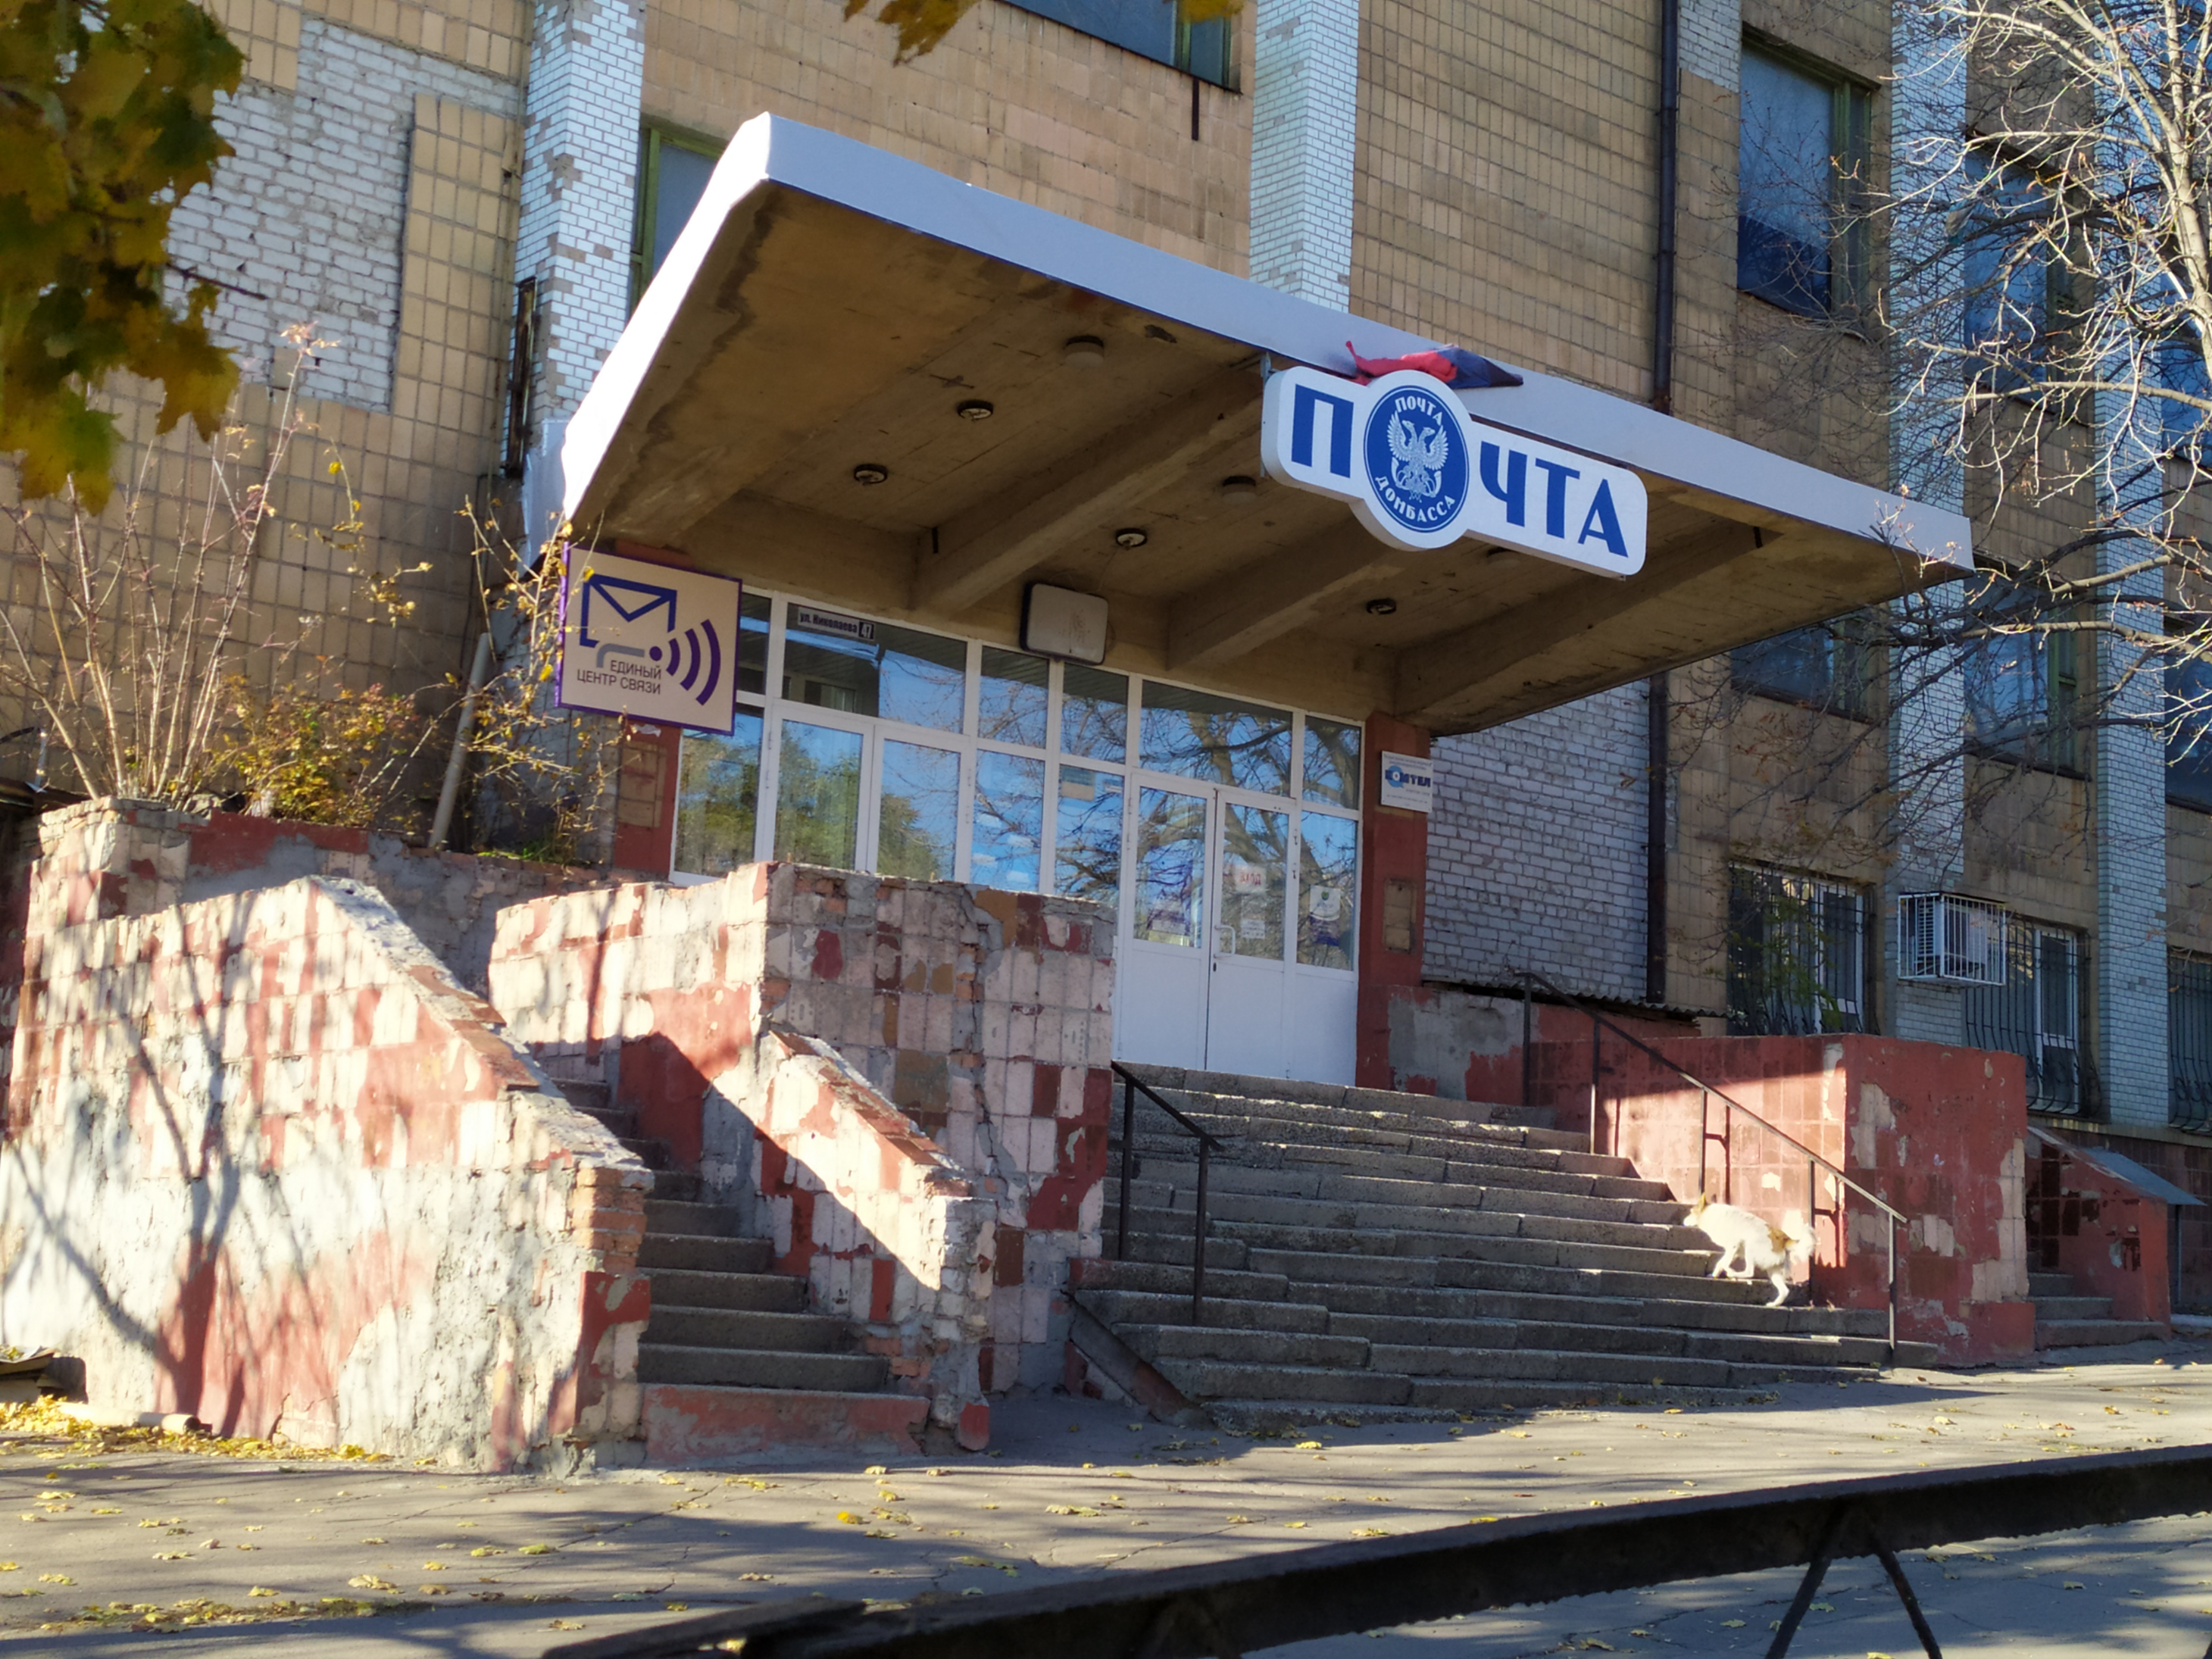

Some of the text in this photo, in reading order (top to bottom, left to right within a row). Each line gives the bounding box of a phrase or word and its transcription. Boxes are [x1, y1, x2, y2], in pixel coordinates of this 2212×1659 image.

[1395, 395, 1443, 426] ПОЧТА
[1375, 476, 1455, 523] ДОНБАССА
[577, 669, 661, 695] ЦЕНТР СВЯЗИ
[610, 660, 662, 680] ЕДИНЫЙ
